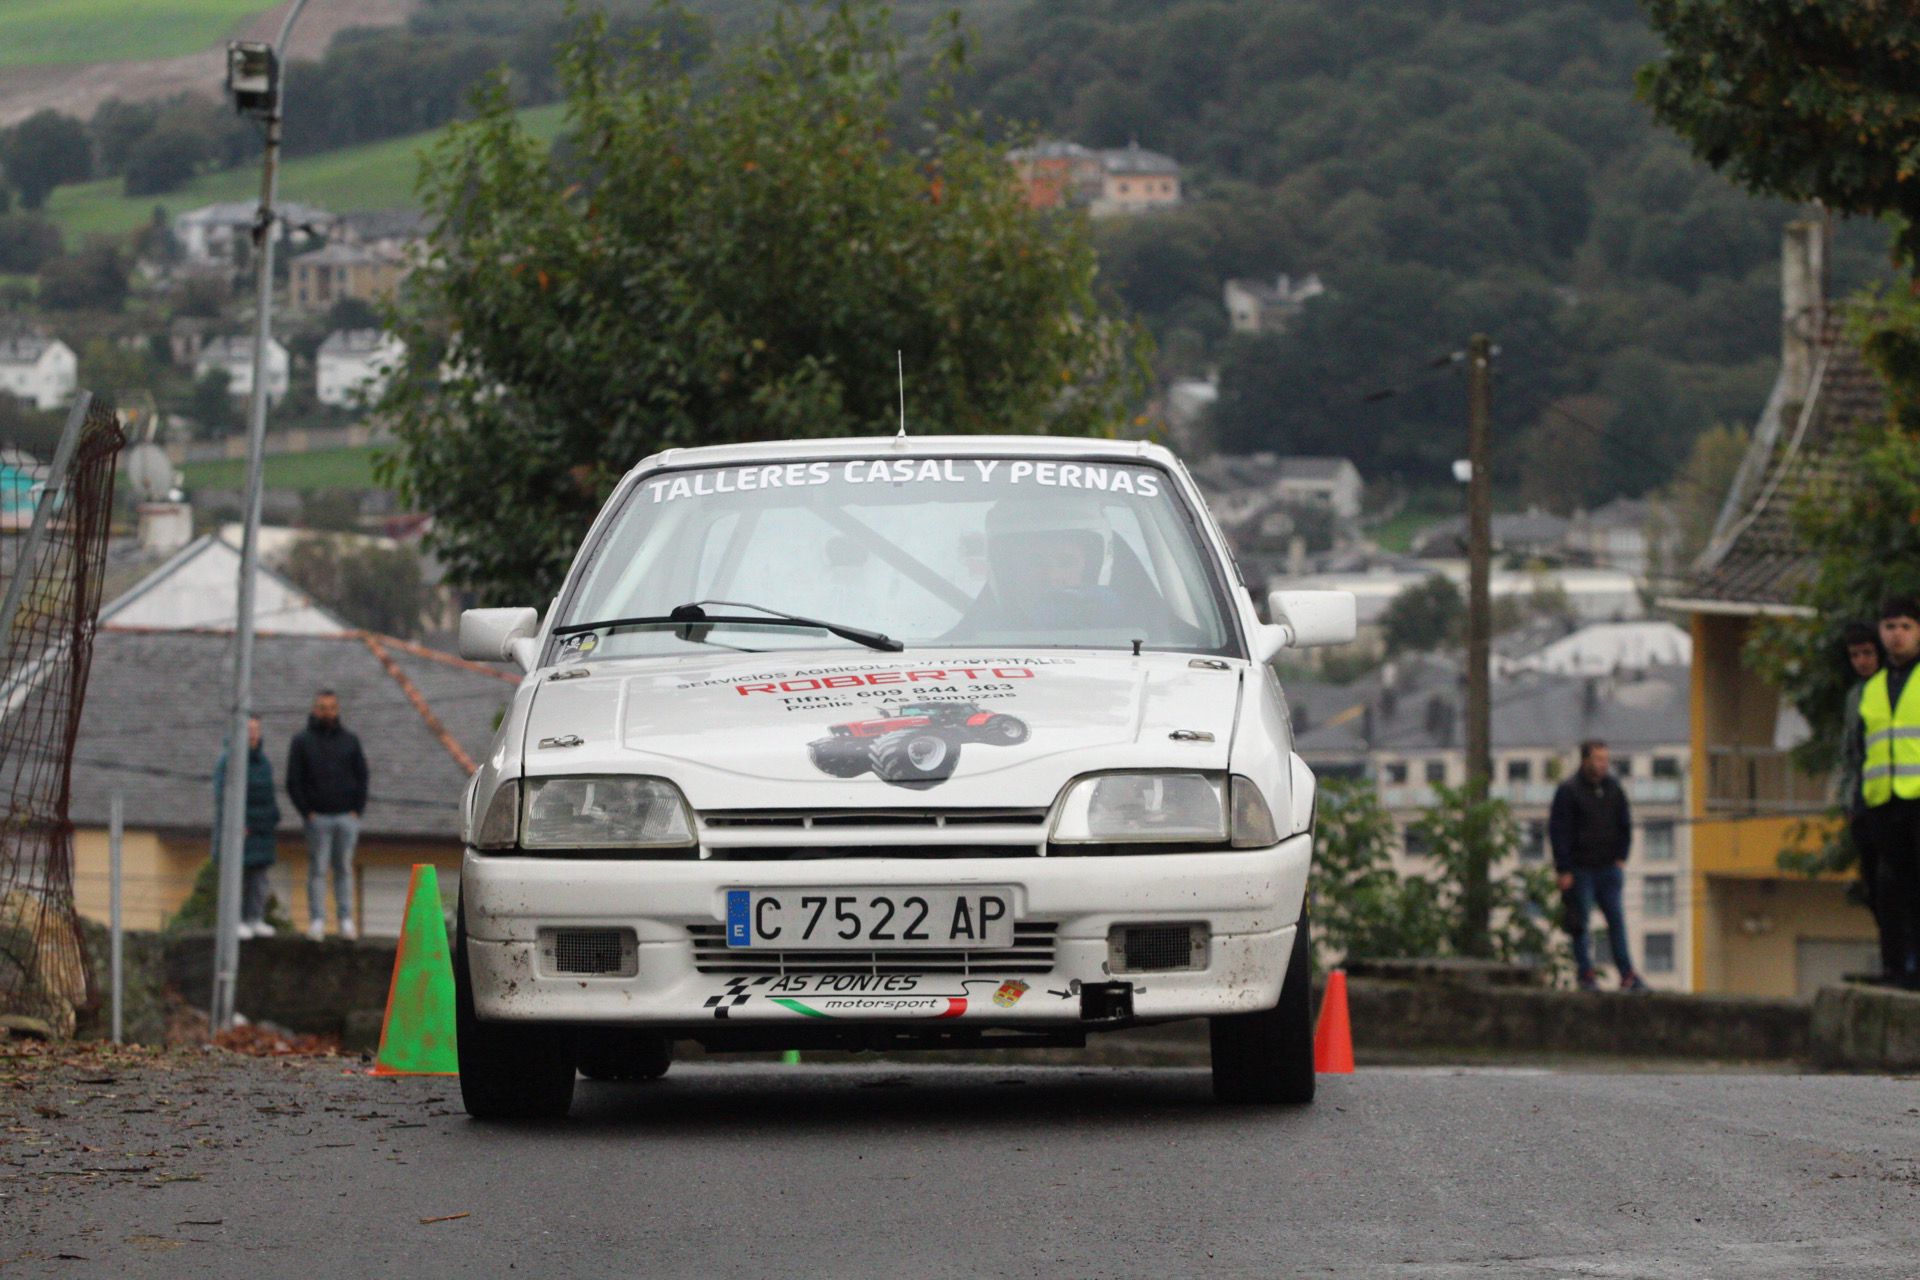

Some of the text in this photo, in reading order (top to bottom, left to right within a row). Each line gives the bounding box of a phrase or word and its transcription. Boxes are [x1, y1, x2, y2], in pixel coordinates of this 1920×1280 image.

[648, 459, 1159, 503] TALLERES CASAL Y PERNAS
[735, 667, 1035, 696] ROBERTO
[857, 688, 903, 698] 609
[912, 685, 958, 694] 844
[968, 683, 1015, 692] 363
[917, 692, 1017, 702] Somozas
[755, 896, 1006, 940] C 7522 AP
[733, 925, 745, 937] E
[769, 975, 923, 992] AS PONTES
[824, 998, 940, 1011] motorsport
